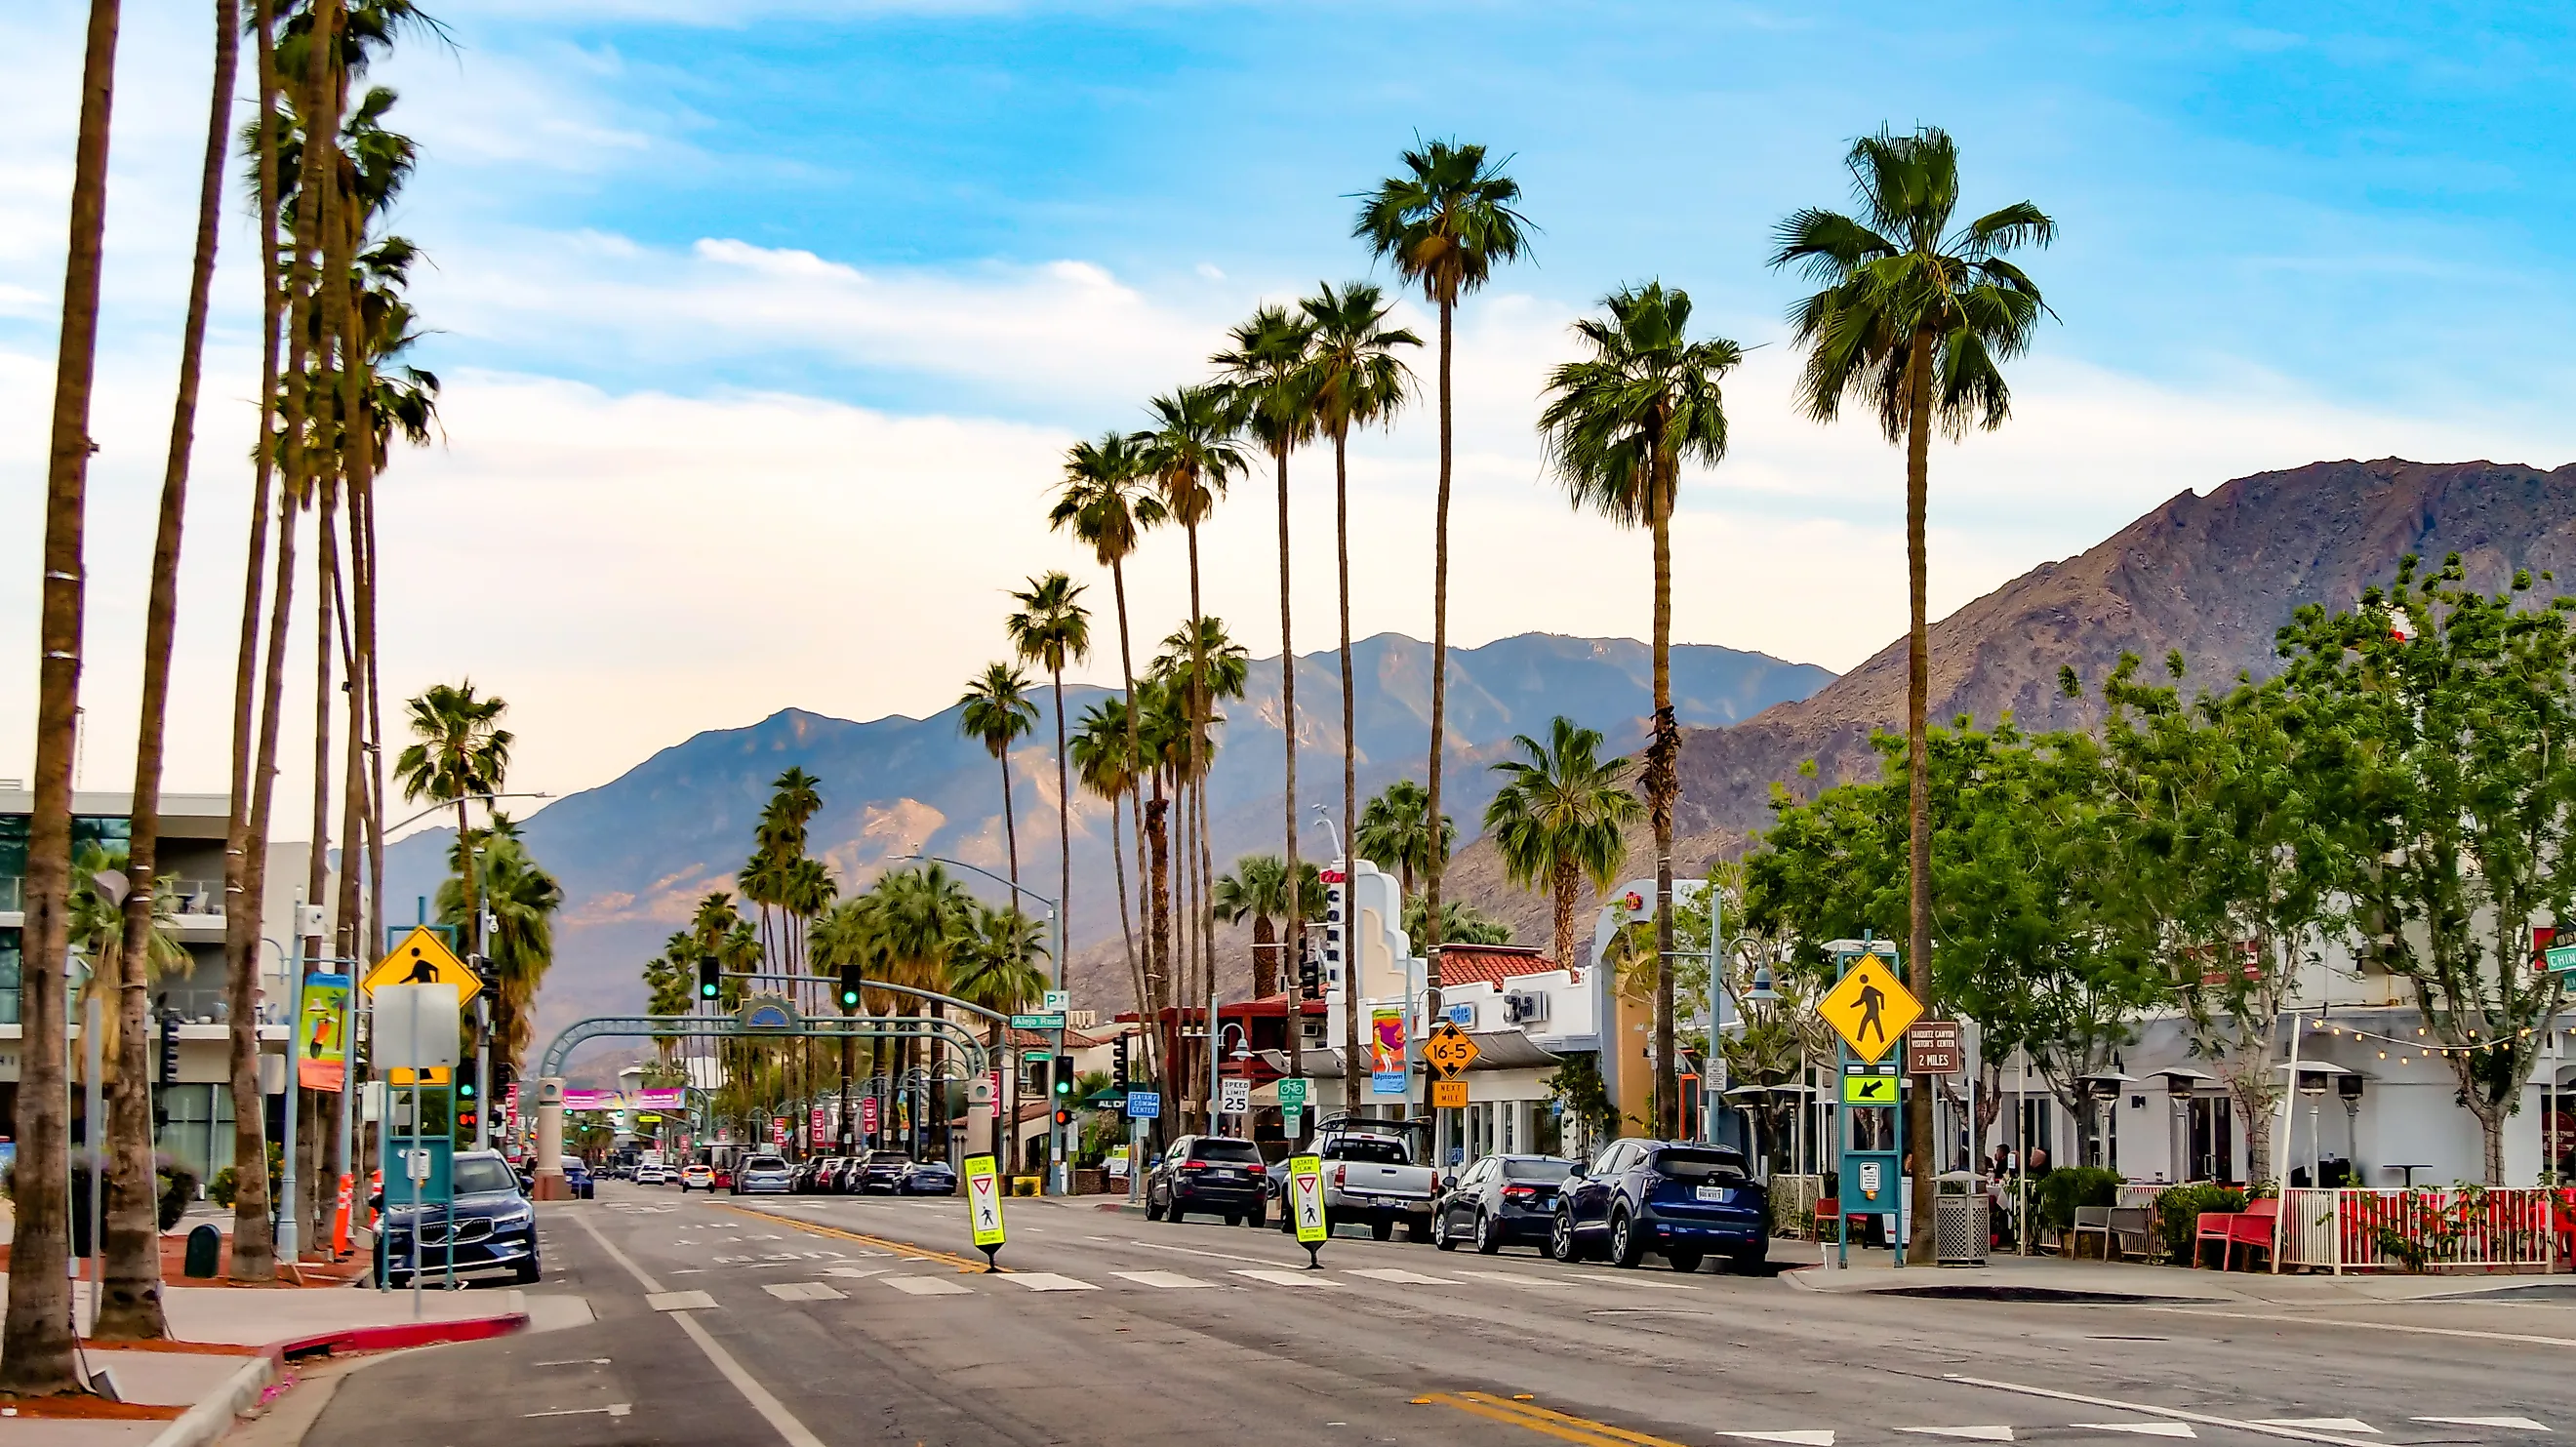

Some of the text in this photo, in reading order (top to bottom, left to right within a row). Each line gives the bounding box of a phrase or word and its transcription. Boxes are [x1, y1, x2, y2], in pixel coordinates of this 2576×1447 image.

[1047, 994, 1057, 1007] P
[1015, 1017, 1063, 1026] Alejo Road
[1937, 1039, 1954, 1048] CENTER
[1918, 1054, 1949, 1066] 2 MILES
[1374, 1072, 1403, 1081] Uptown
[1225, 1098, 1246, 1110] 25
